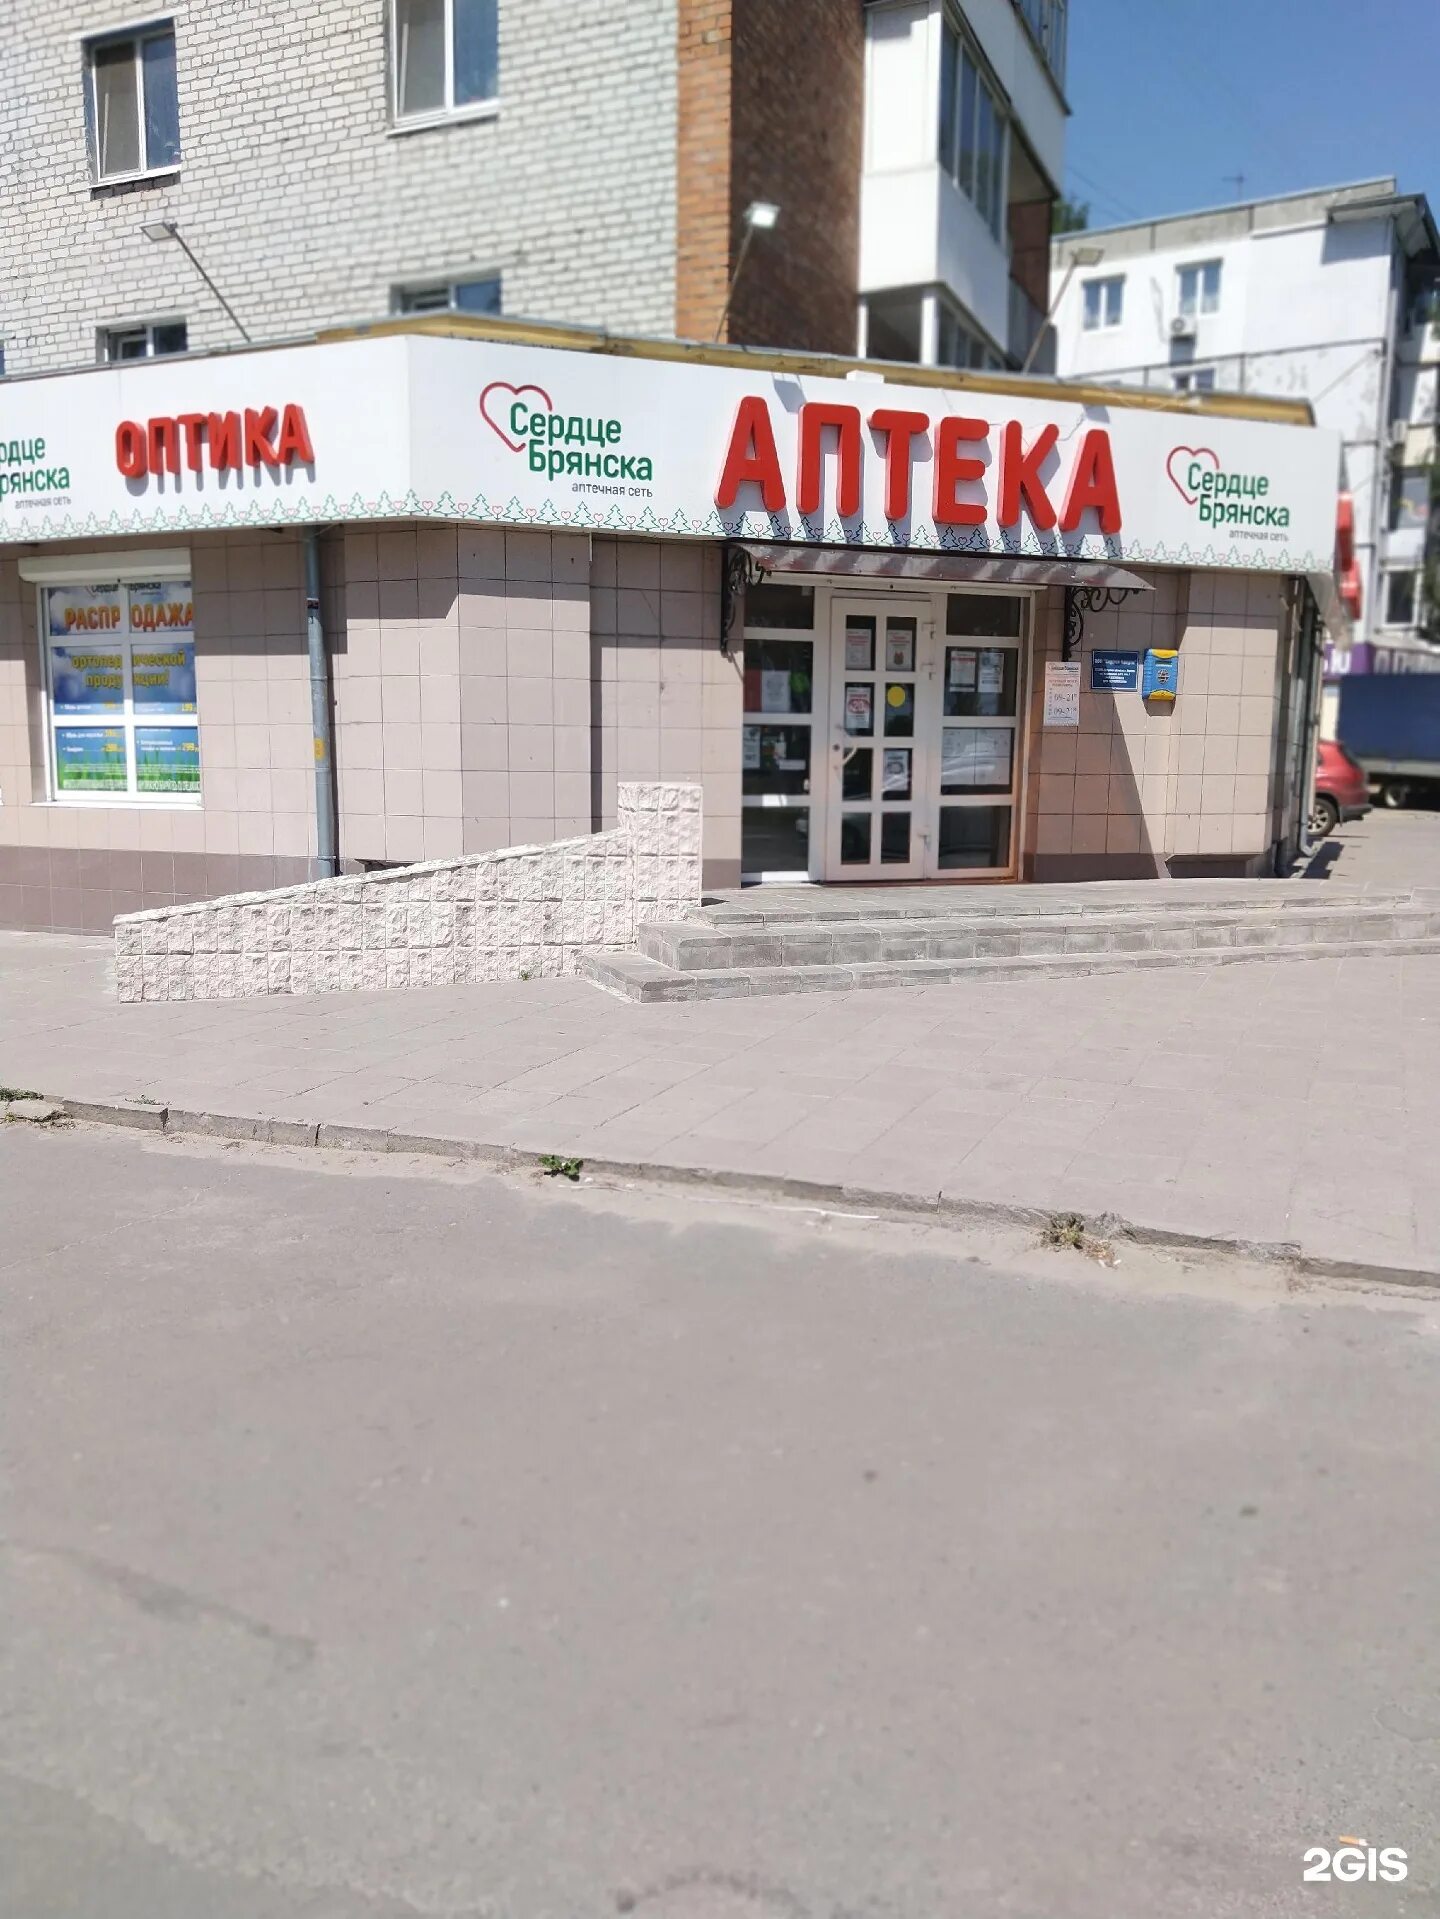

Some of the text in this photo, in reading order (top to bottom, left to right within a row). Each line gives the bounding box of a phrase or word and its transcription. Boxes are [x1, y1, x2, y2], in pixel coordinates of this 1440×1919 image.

[115, 403, 315, 479] ОПТИКА
[510, 402, 622, 448] Сердце
[529, 439, 653, 482] Брянска
[717, 395, 1121, 532] АПТЕКА
[571, 482, 653, 498] аптечная сеть
[1188, 462, 1269, 500] Сердце
[15, 496, 72, 510] аптечная сеть
[1199, 493, 1290, 529] Брянска
[1229, 530, 1289, 542] аптечная сеть
